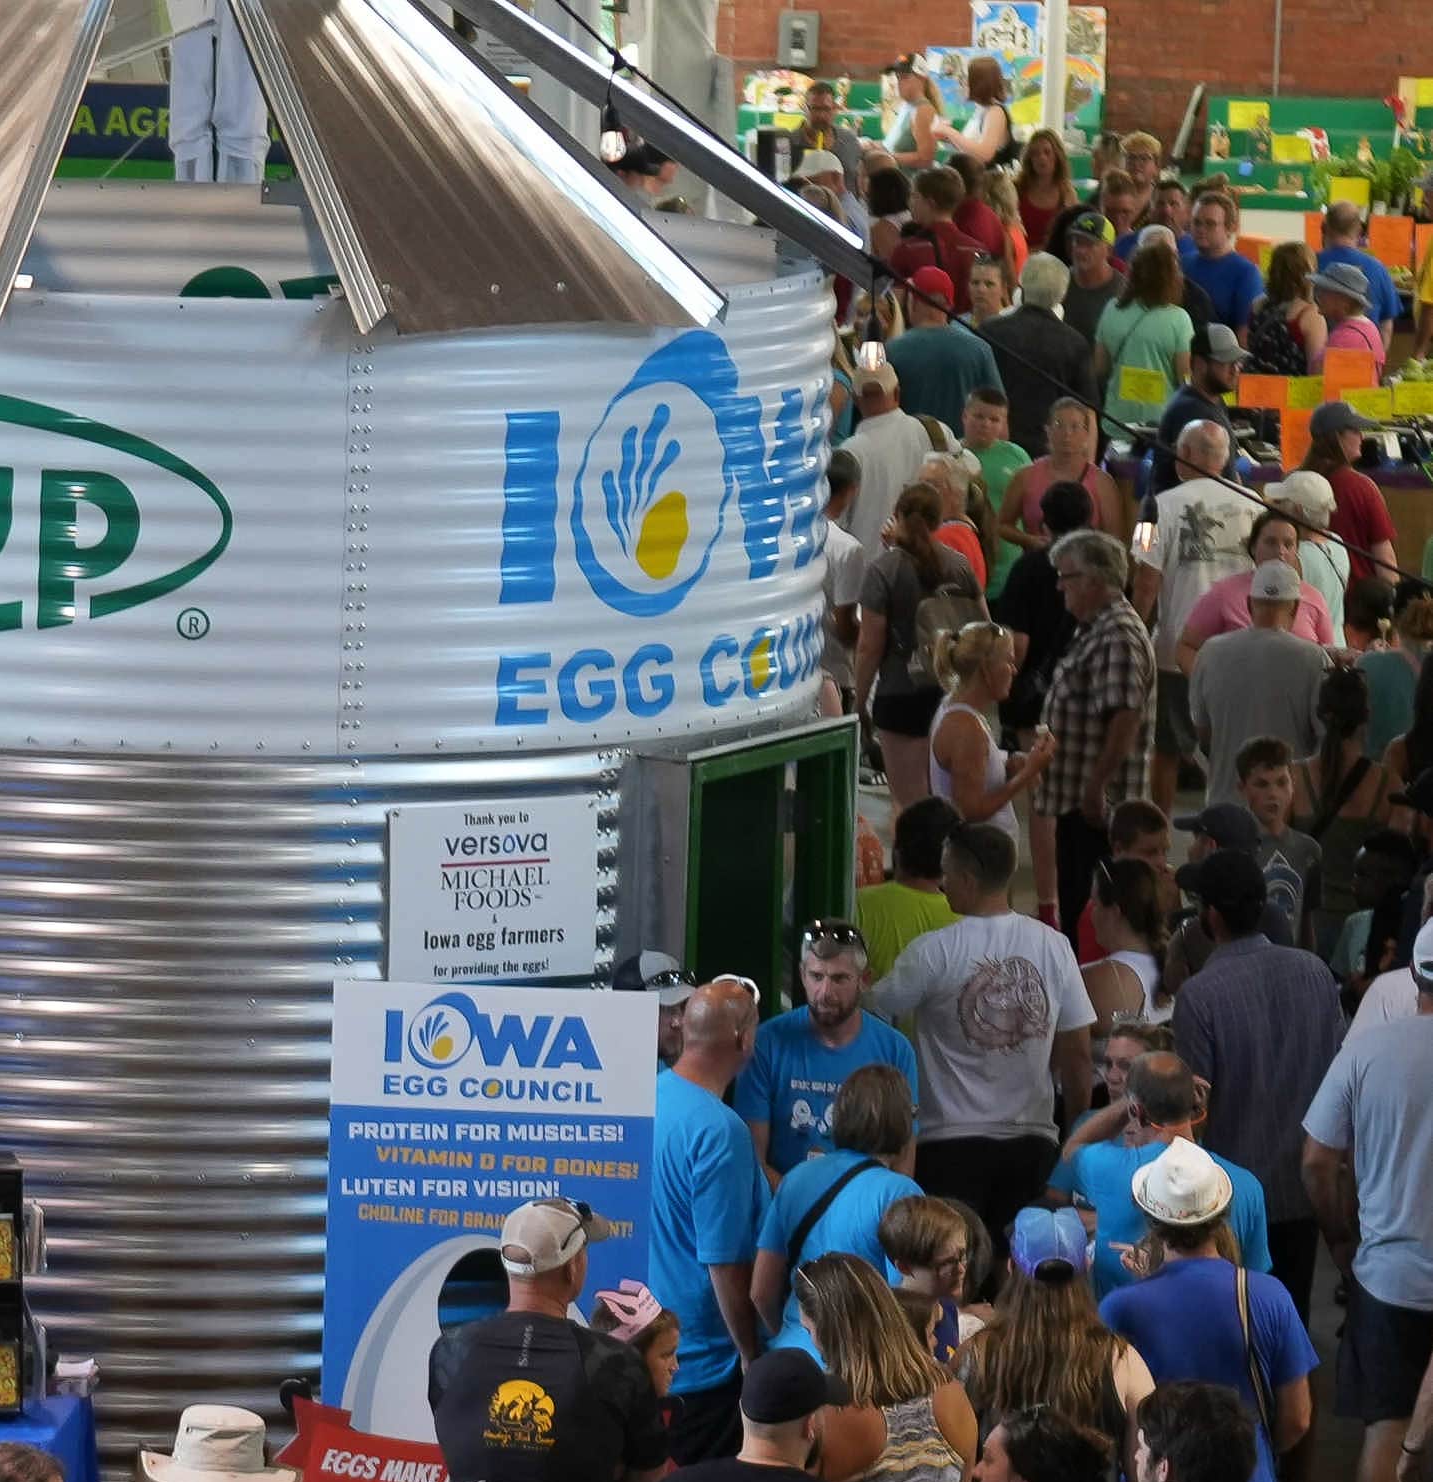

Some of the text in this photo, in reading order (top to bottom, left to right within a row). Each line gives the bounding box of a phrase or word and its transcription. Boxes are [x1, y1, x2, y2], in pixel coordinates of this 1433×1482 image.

[495, 643, 675, 726] EGG
[464, 812, 529, 827] Thank you to
[445, 833, 547, 856] versova
[441, 866, 550, 890] MICHAEL
[455, 888, 531, 910] FOODS
[424, 928, 564, 951] Iowa egg farmers
[434, 958, 550, 978] for providing the eggs!
[384, 992, 603, 1070] IOWA
[383, 1074, 602, 1102] EGG COUNCIL
[348, 1121, 624, 1142] PROTEIN FOR MUSCLES!
[376, 1145, 639, 1179] VITAMIN D FOR BONES!
[341, 1179, 560, 1199] LUTEN FOR VISION!
[358, 1203, 424, 1225] CHOLINE
[429, 1207, 458, 1226] FOR
[321, 1448, 380, 1480] EGGS
